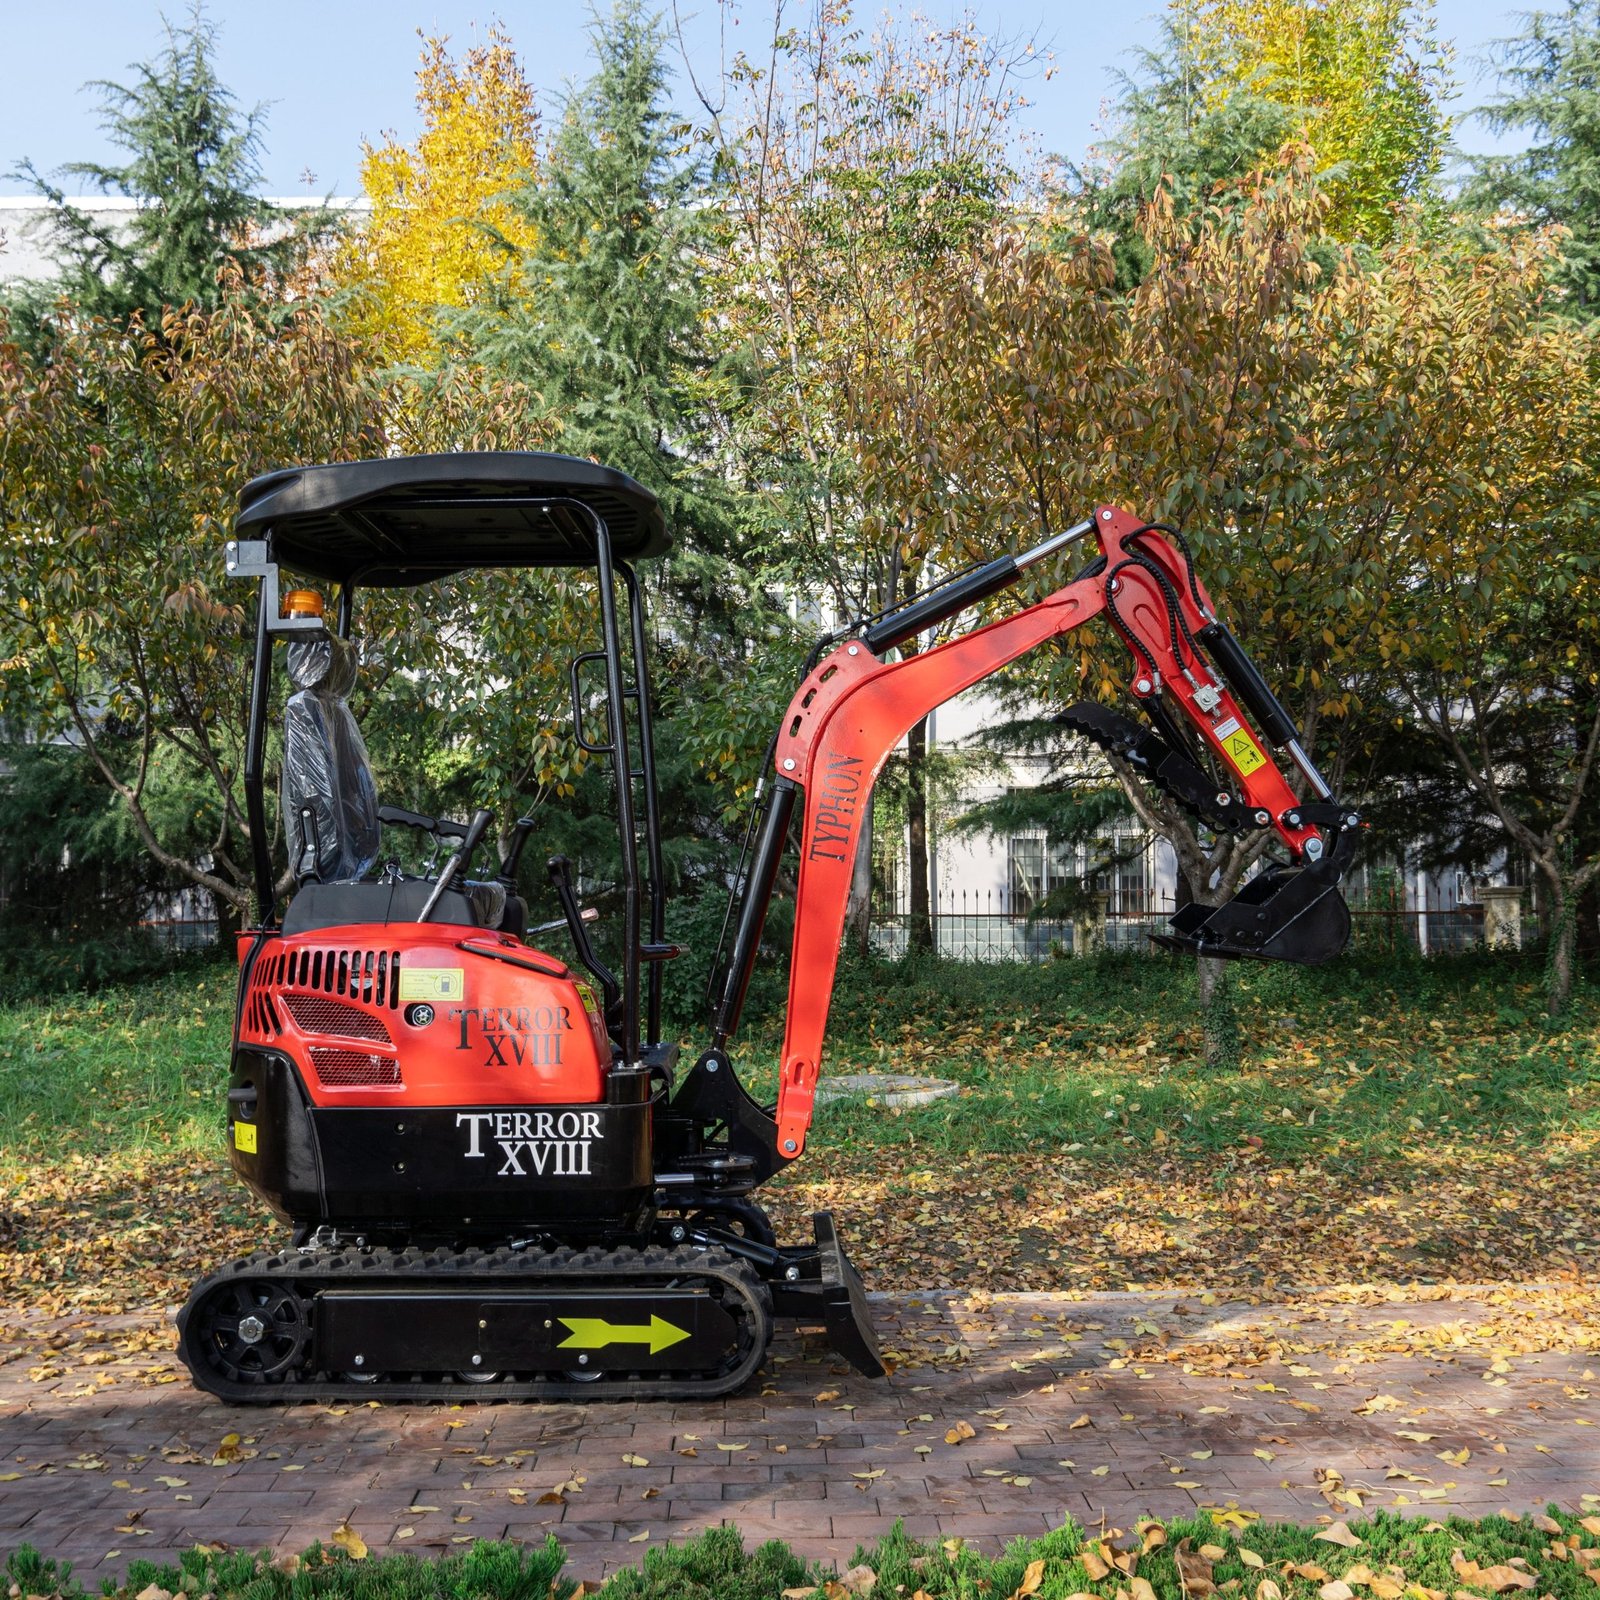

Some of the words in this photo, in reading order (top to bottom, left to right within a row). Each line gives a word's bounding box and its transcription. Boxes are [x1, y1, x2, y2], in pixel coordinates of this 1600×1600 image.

[809, 753, 863, 862] TYPHON
[449, 1006, 573, 1050] TERROR
[484, 1034, 563, 1066] XVIII
[456, 1112, 604, 1157] TERROR
[497, 1140, 592, 1175] XVIII
